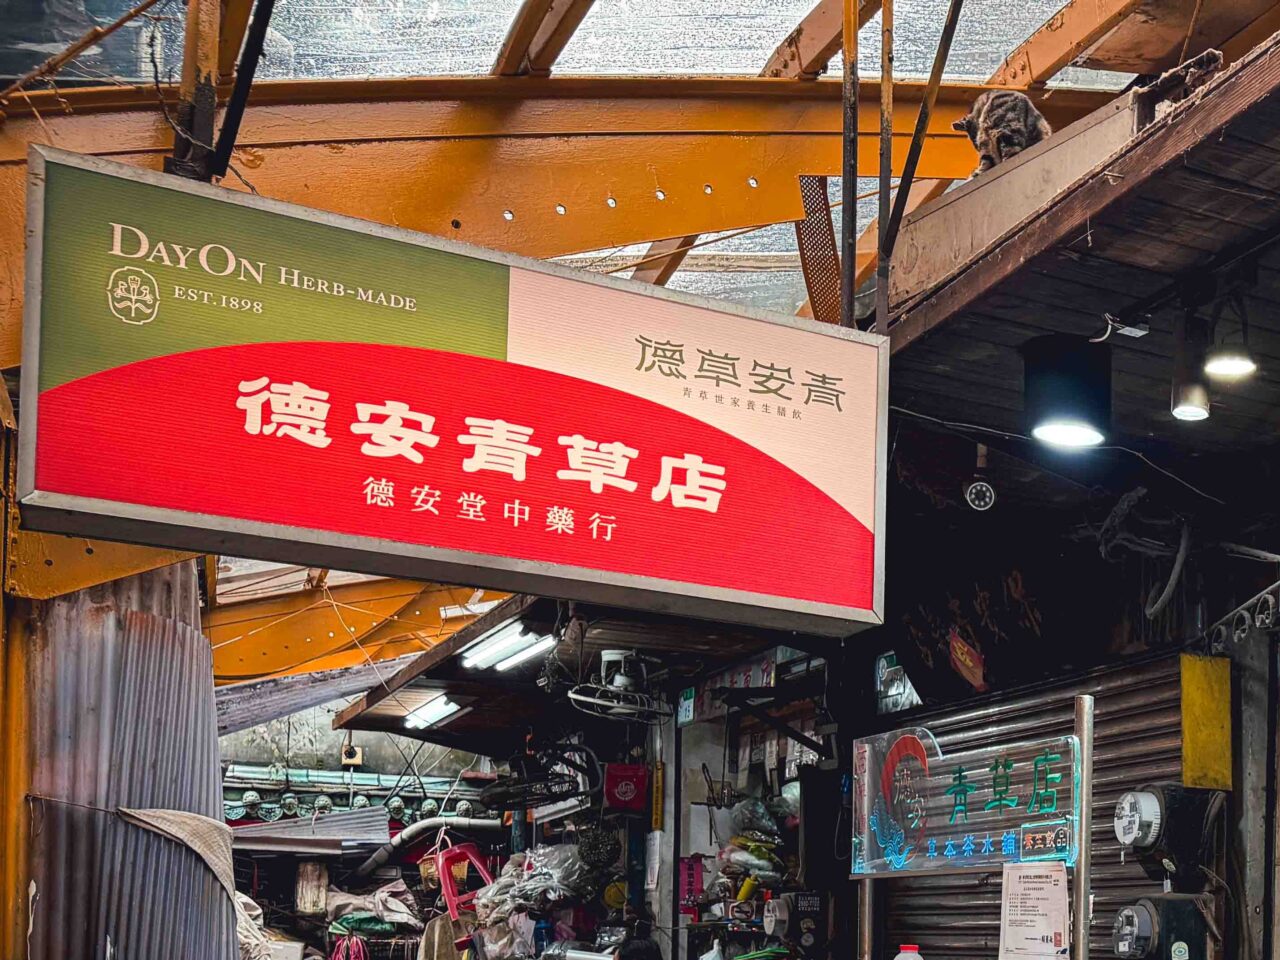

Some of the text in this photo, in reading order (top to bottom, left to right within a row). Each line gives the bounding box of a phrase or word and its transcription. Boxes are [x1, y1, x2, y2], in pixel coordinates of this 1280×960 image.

[173, 285, 263, 314] EST.1898
[236, 375, 728, 514] 德安青草店
[362, 476, 619, 542] 德安堂中藥行
[944, 748, 1063, 825] 青草店
